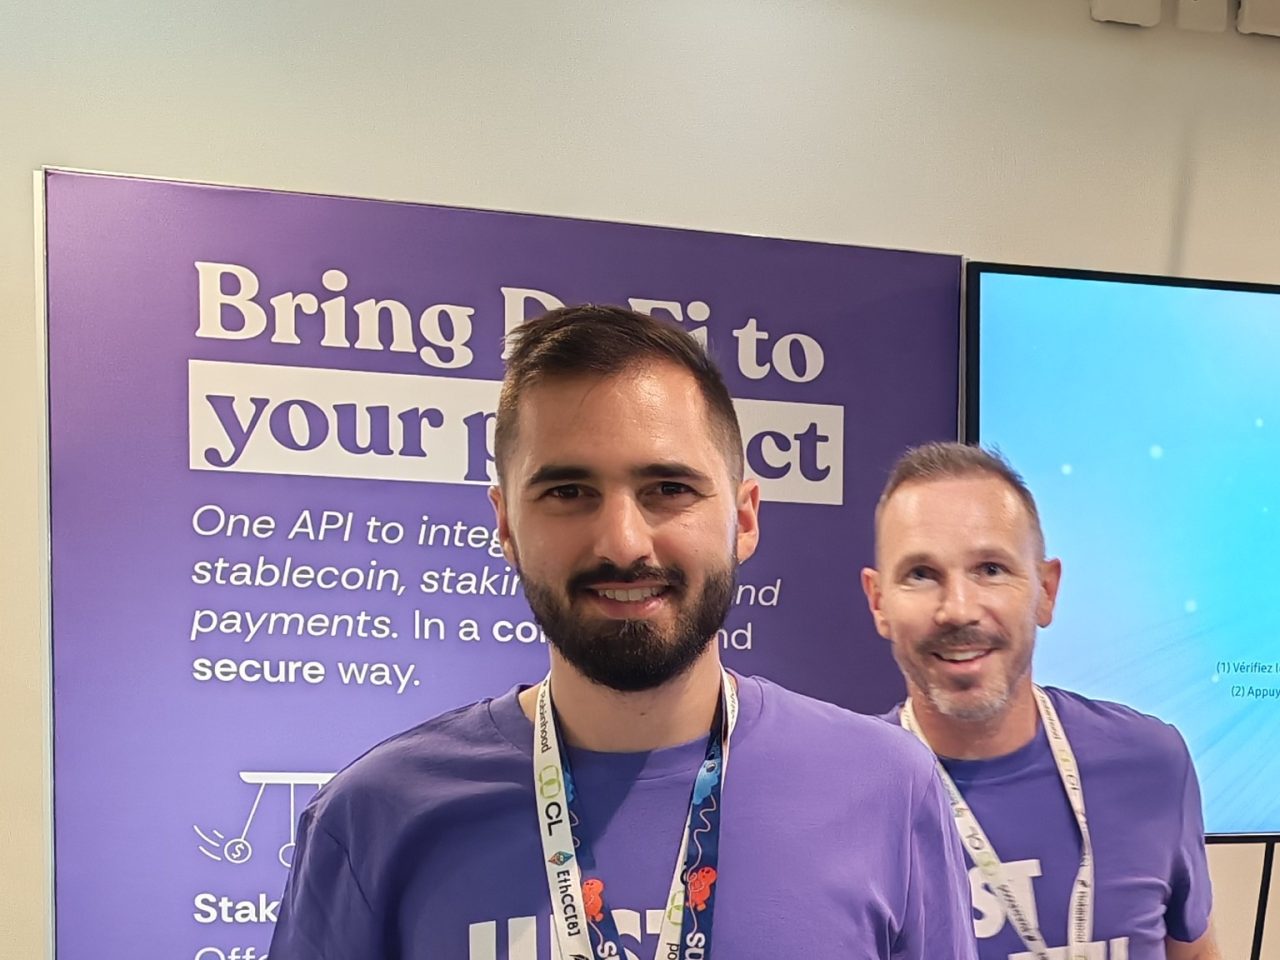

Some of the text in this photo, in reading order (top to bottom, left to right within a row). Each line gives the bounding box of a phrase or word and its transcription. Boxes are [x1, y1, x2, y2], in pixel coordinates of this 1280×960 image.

[194, 260, 475, 370] Bring
[732, 317, 825, 383] to
[203, 393, 444, 468] your
[191, 503, 505, 557] One API to integ
[190, 555, 407, 597] stablecoin,
[736, 579, 782, 607] nd
[190, 608, 399, 642] payments.
[414, 609, 445, 641] In
[458, 618, 481, 641] a
[717, 622, 752, 651] nd
[191, 656, 421, 694] secure way.
[1216, 662, 1231, 675] (1)
[1233, 661, 1273, 675] Vérifiez
[1231, 686, 1245, 698] (2)
[545, 801, 563, 836] CL
[193, 893, 281, 924] Stak
[556, 869, 581, 937] EthCC[8]
